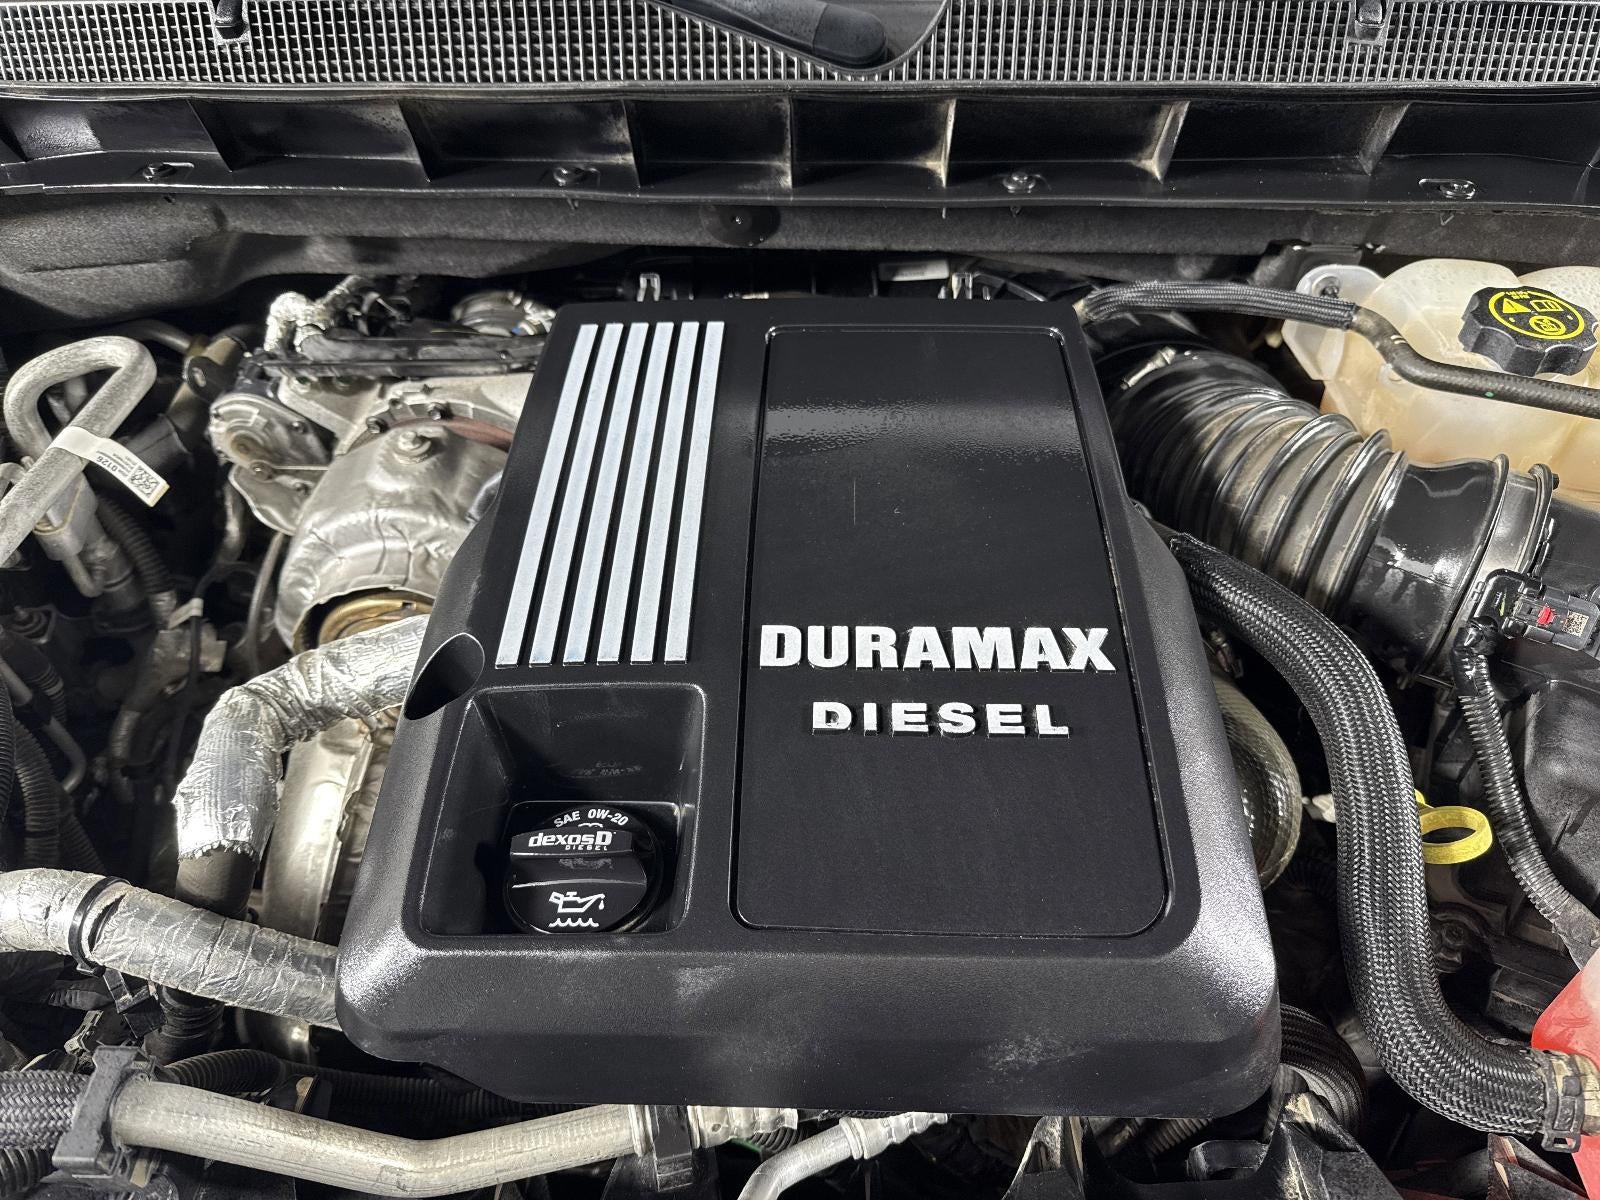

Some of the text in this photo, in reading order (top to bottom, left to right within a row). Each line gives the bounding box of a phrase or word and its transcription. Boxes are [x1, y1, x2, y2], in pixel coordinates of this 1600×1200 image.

[760, 625, 1115, 672] DURAMAX
[811, 701, 1071, 737] DIESEL
[554, 808, 629, 828] SAE 0W-20
